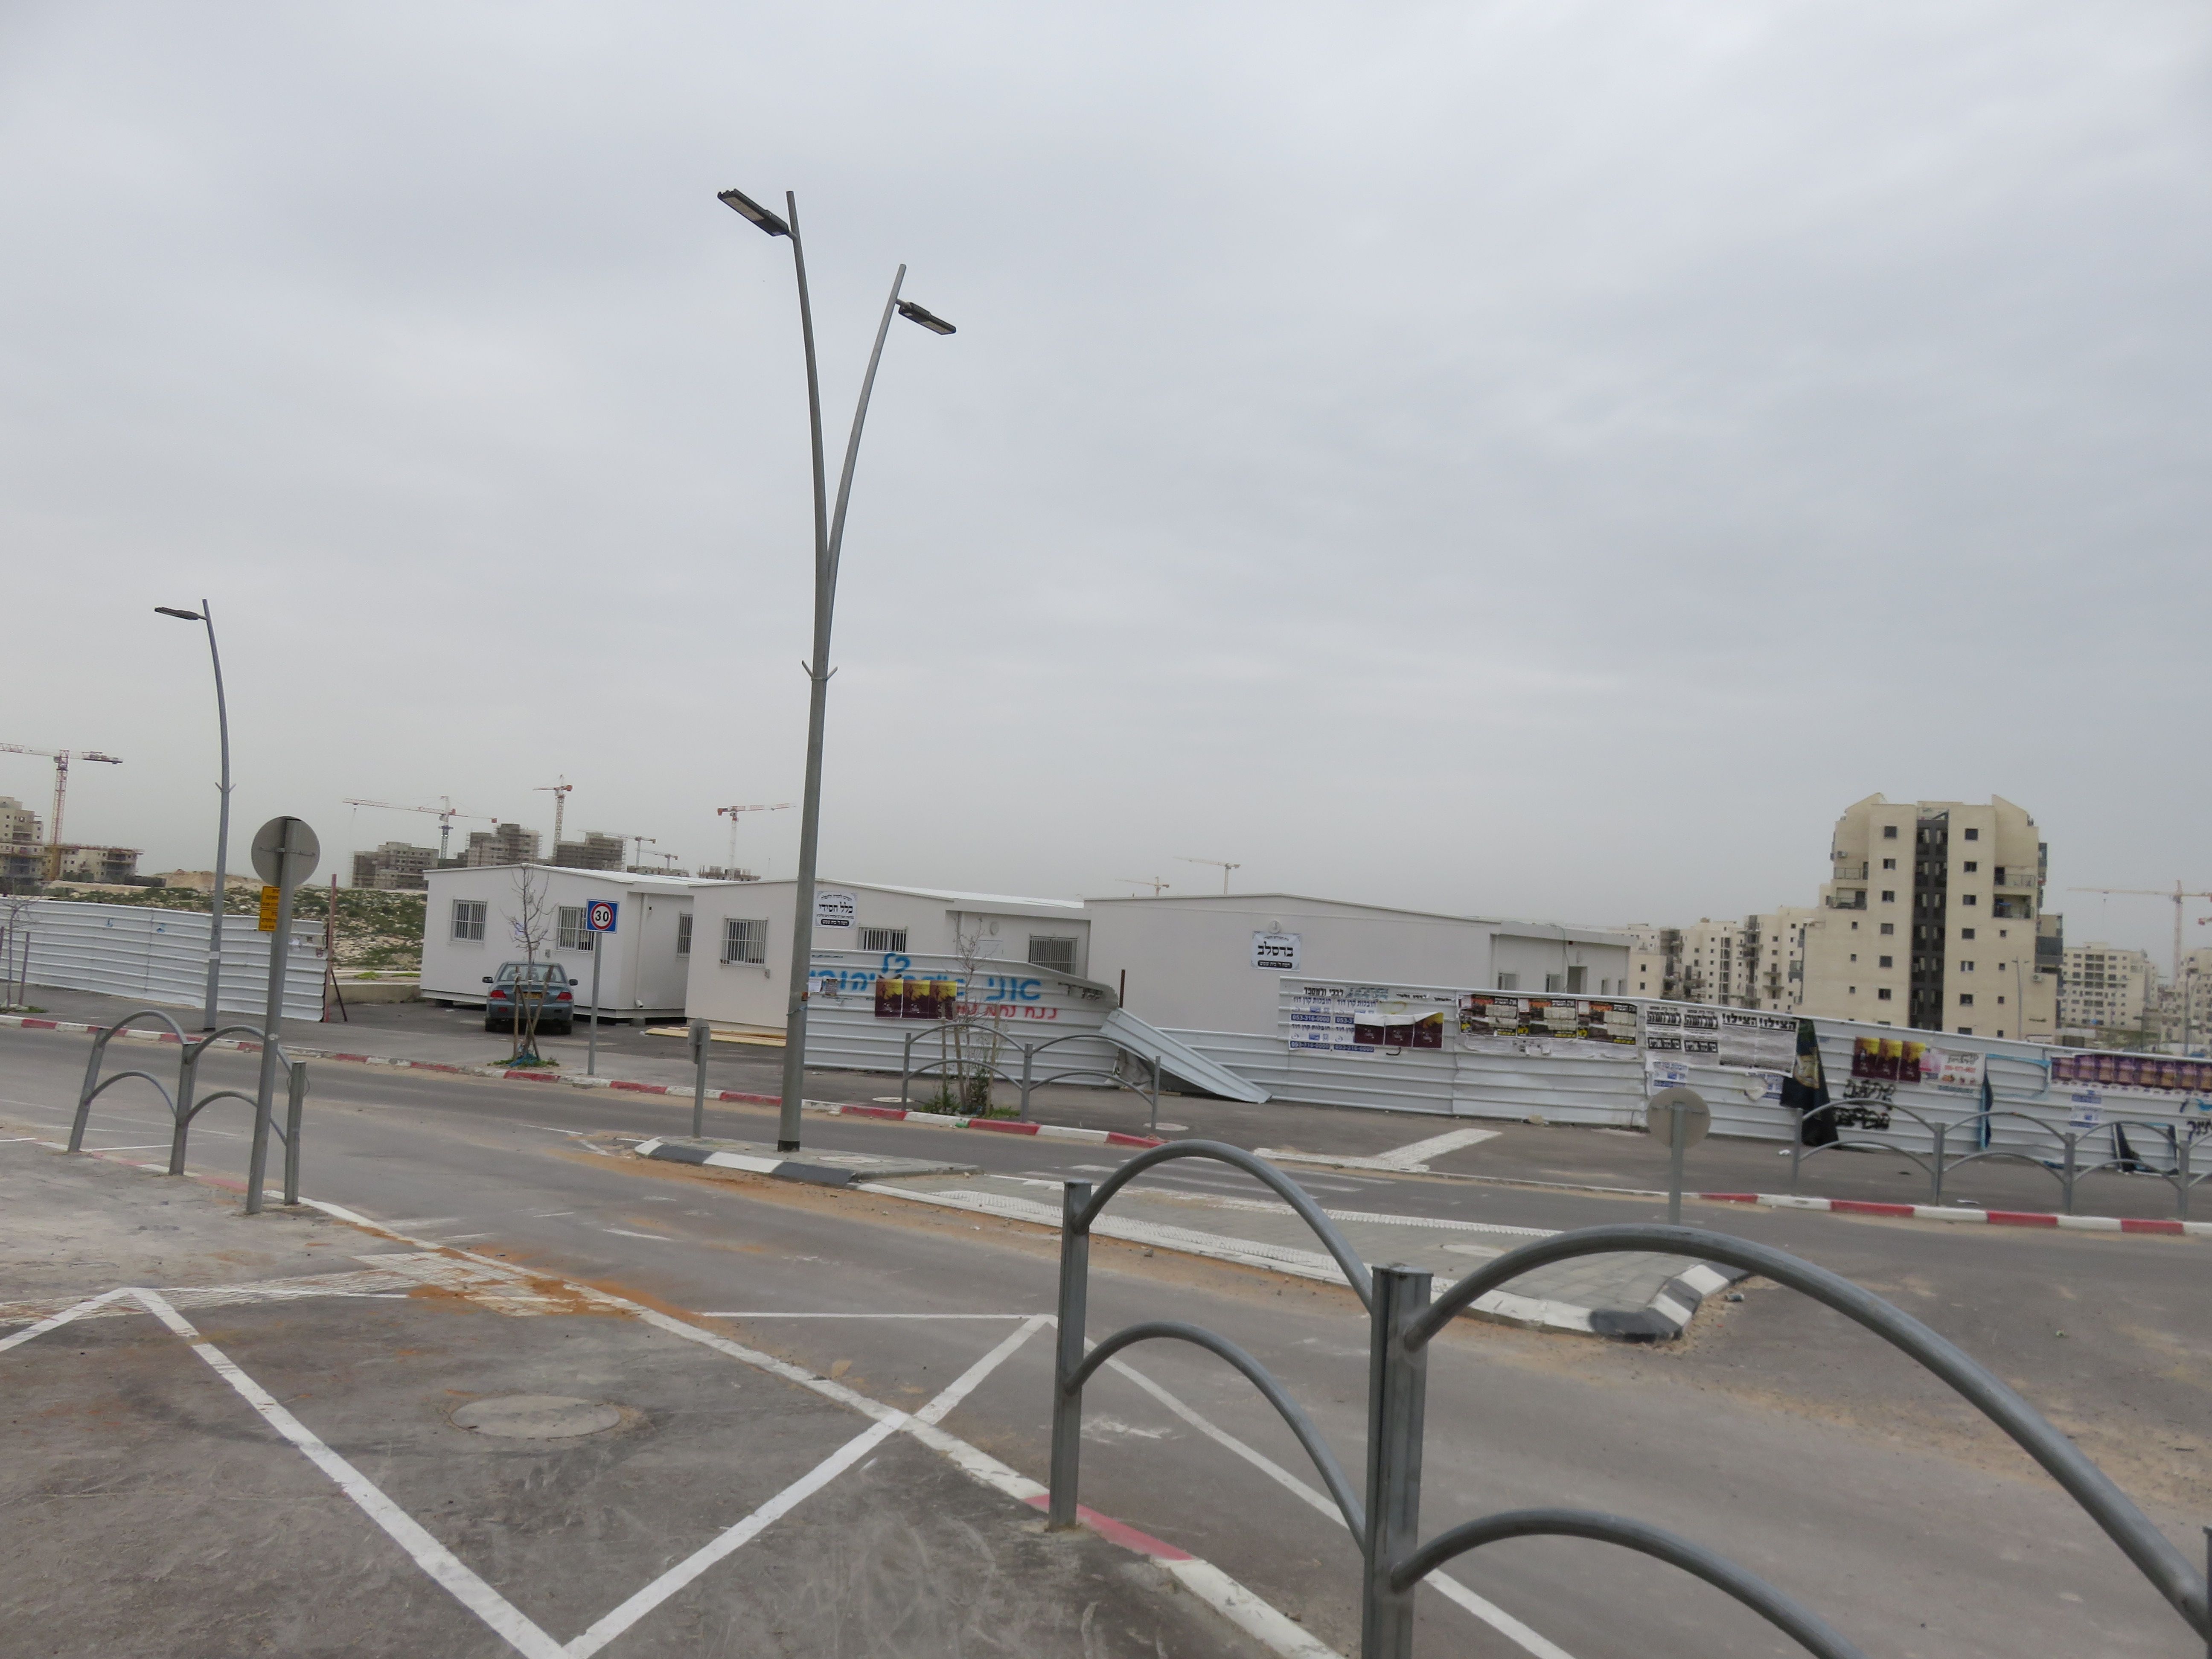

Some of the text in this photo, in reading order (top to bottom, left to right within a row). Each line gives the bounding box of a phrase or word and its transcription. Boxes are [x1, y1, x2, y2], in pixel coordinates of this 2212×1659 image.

[819, 901, 853, 913] כלל חסידי
[595, 910, 609, 922] 30
[1257, 941, 1293, 957] ברסלב
[1292, 1014, 1330, 1022] 053-316-0000
[1722, 1013, 1757, 1026] הצילו!
[1759, 1017, 1797, 1030] הצילו!
